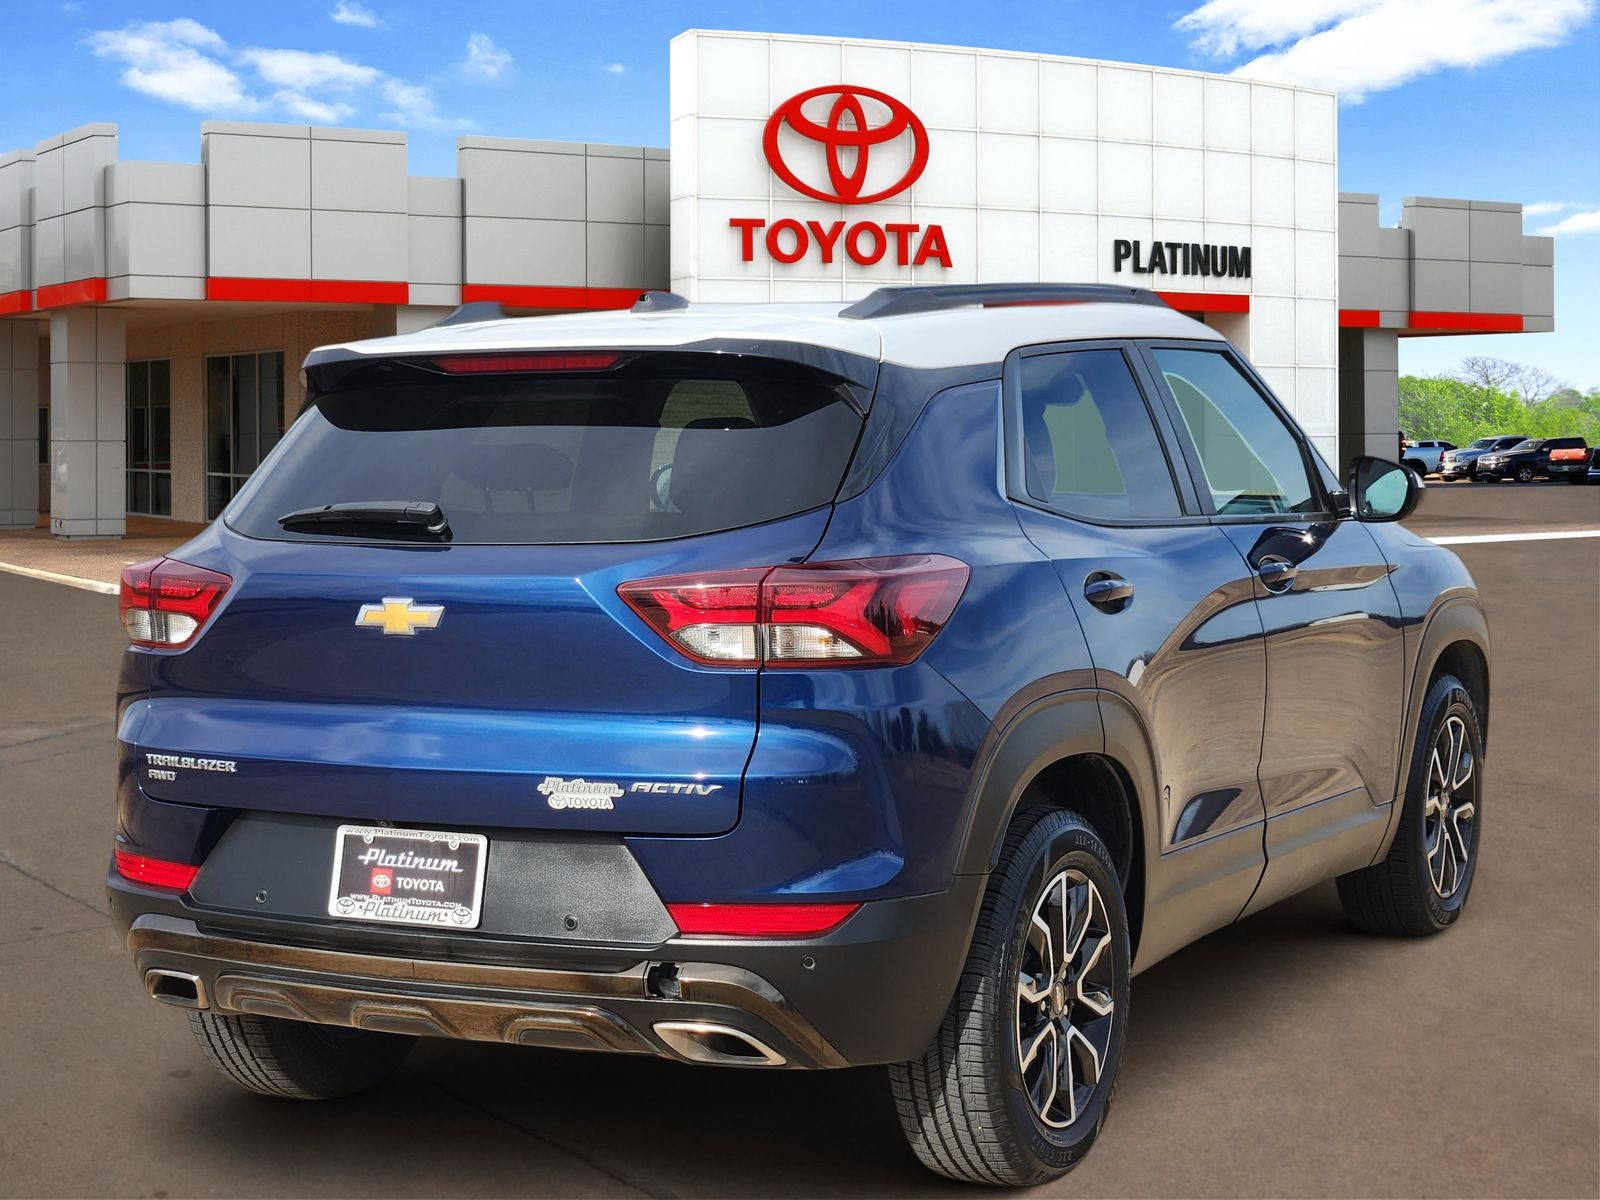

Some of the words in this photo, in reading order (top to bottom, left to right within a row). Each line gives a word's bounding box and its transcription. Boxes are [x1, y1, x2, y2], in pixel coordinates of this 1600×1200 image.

[729, 218, 953, 268] TOYOTA
[1114, 239, 1252, 278] PLATINUM
[145, 753, 237, 773] TRAILBLAZER
[148, 769, 176, 781] AWD
[539, 777, 623, 797] Platinum
[631, 782, 722, 796] ACTIV
[567, 797, 614, 809] TOYOTA
[345, 826, 480, 843] www.PlatinumToyota.com
[357, 848, 464, 873] Platinum
[396, 876, 445, 892] TOYOTA
[360, 901, 449, 922] Platinum
